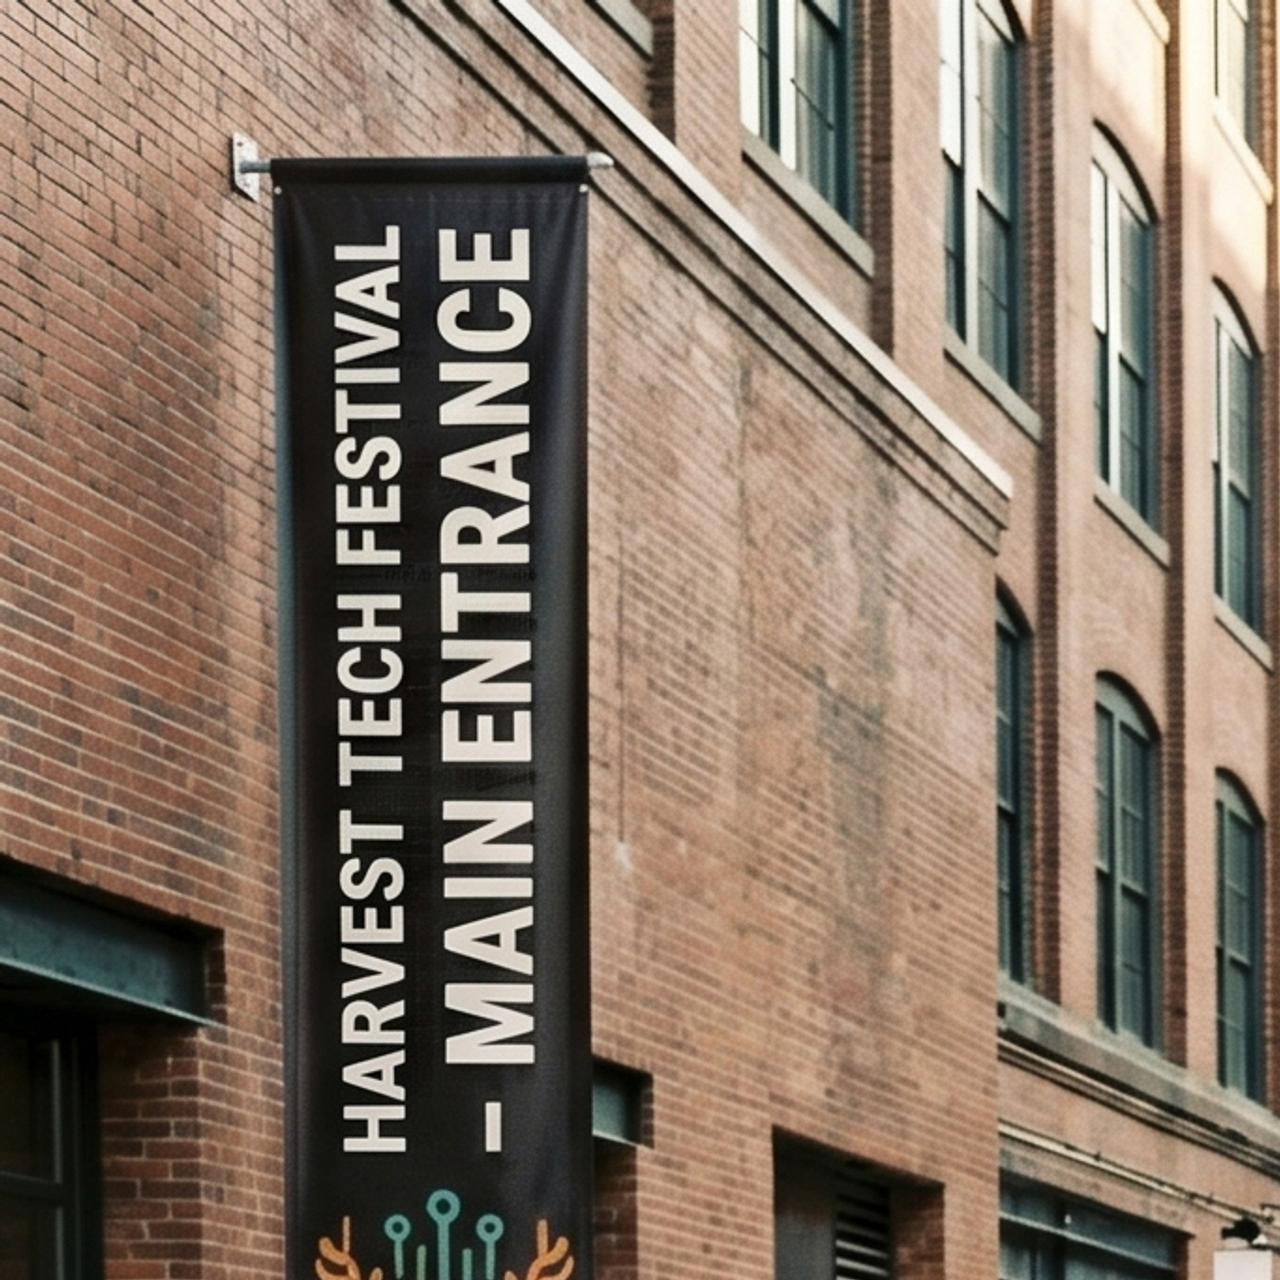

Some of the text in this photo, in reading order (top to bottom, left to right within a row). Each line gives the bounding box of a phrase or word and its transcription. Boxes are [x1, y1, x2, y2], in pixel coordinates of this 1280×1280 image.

[334, 225, 407, 1153] HARVEST TECH FESTIVAL
[436, 228, 532, 763] ENTRANCE
[443, 800, 536, 1064] MAIN
